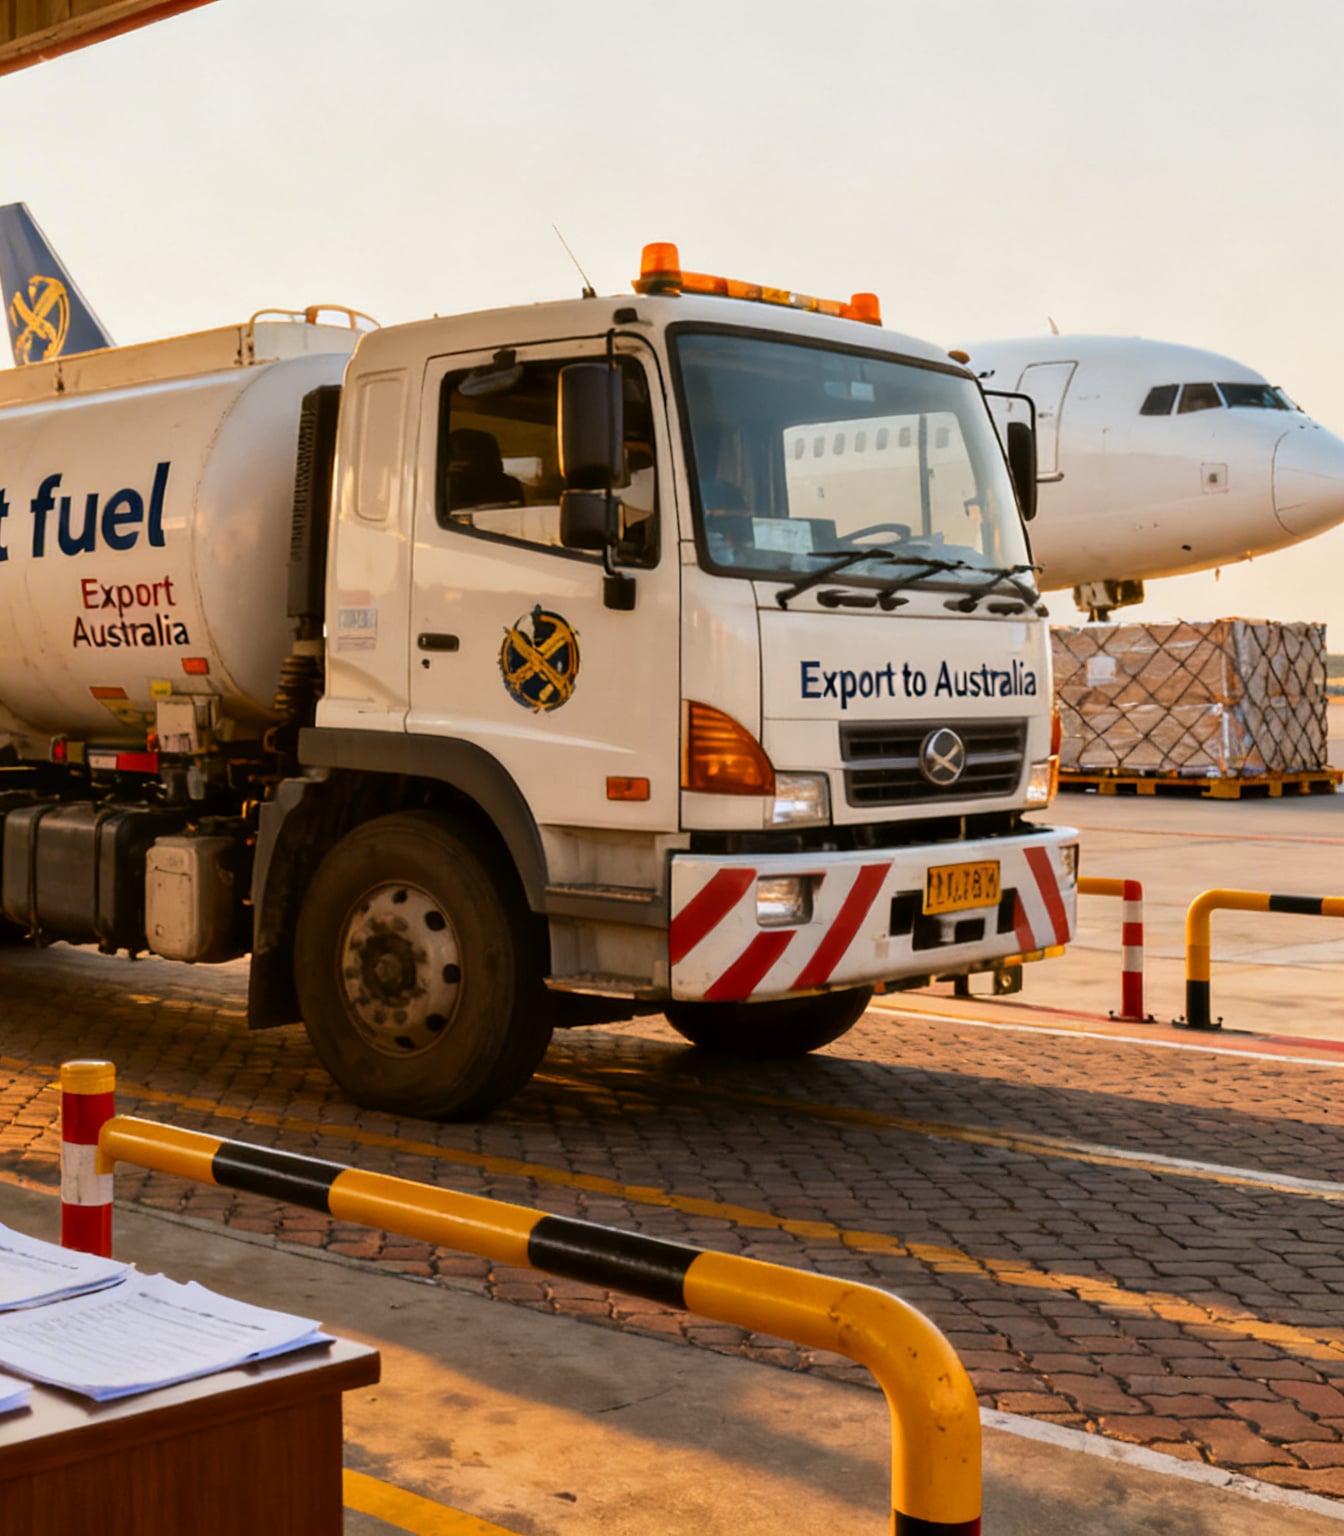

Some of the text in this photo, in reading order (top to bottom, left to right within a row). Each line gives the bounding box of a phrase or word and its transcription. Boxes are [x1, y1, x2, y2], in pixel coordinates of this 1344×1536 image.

[30, 462, 171, 557] fuel
[80, 576, 176, 618] Export
[72, 614, 190, 648] Australia
[800, 659, 1038, 709] Export to Australia
